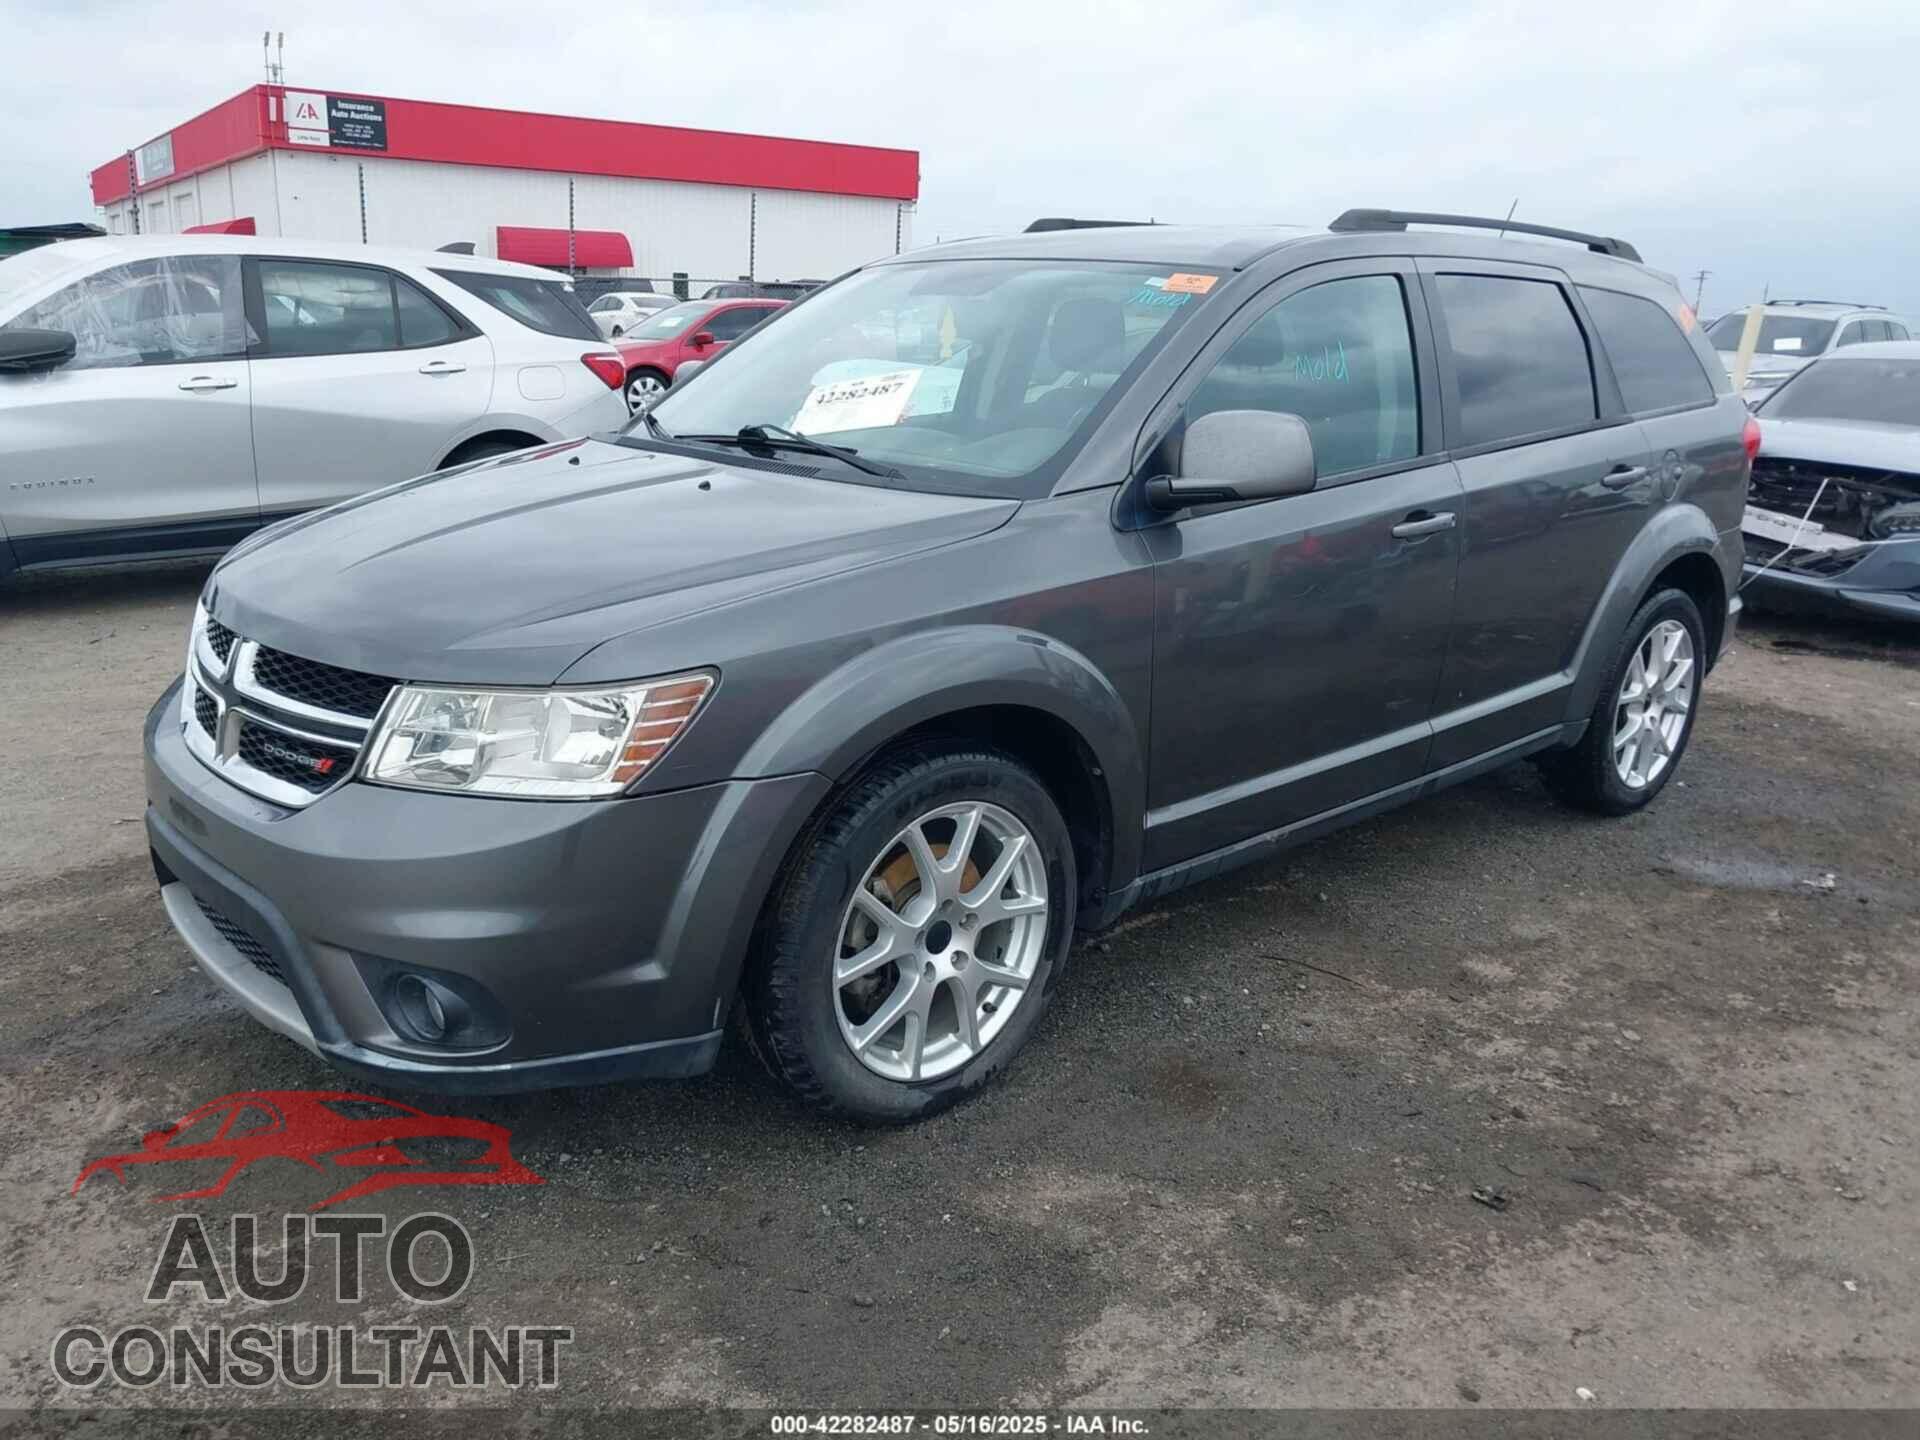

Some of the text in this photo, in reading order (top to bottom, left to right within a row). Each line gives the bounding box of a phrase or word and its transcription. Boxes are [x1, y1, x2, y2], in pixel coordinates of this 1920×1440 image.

[337, 100, 375, 112] Insurance
[331, 109, 382, 121] Auto Auctions
[815, 382, 904, 405] 42282487
[8, 475, 96, 491] EQUINOX
[263, 743, 322, 769] DODGE
